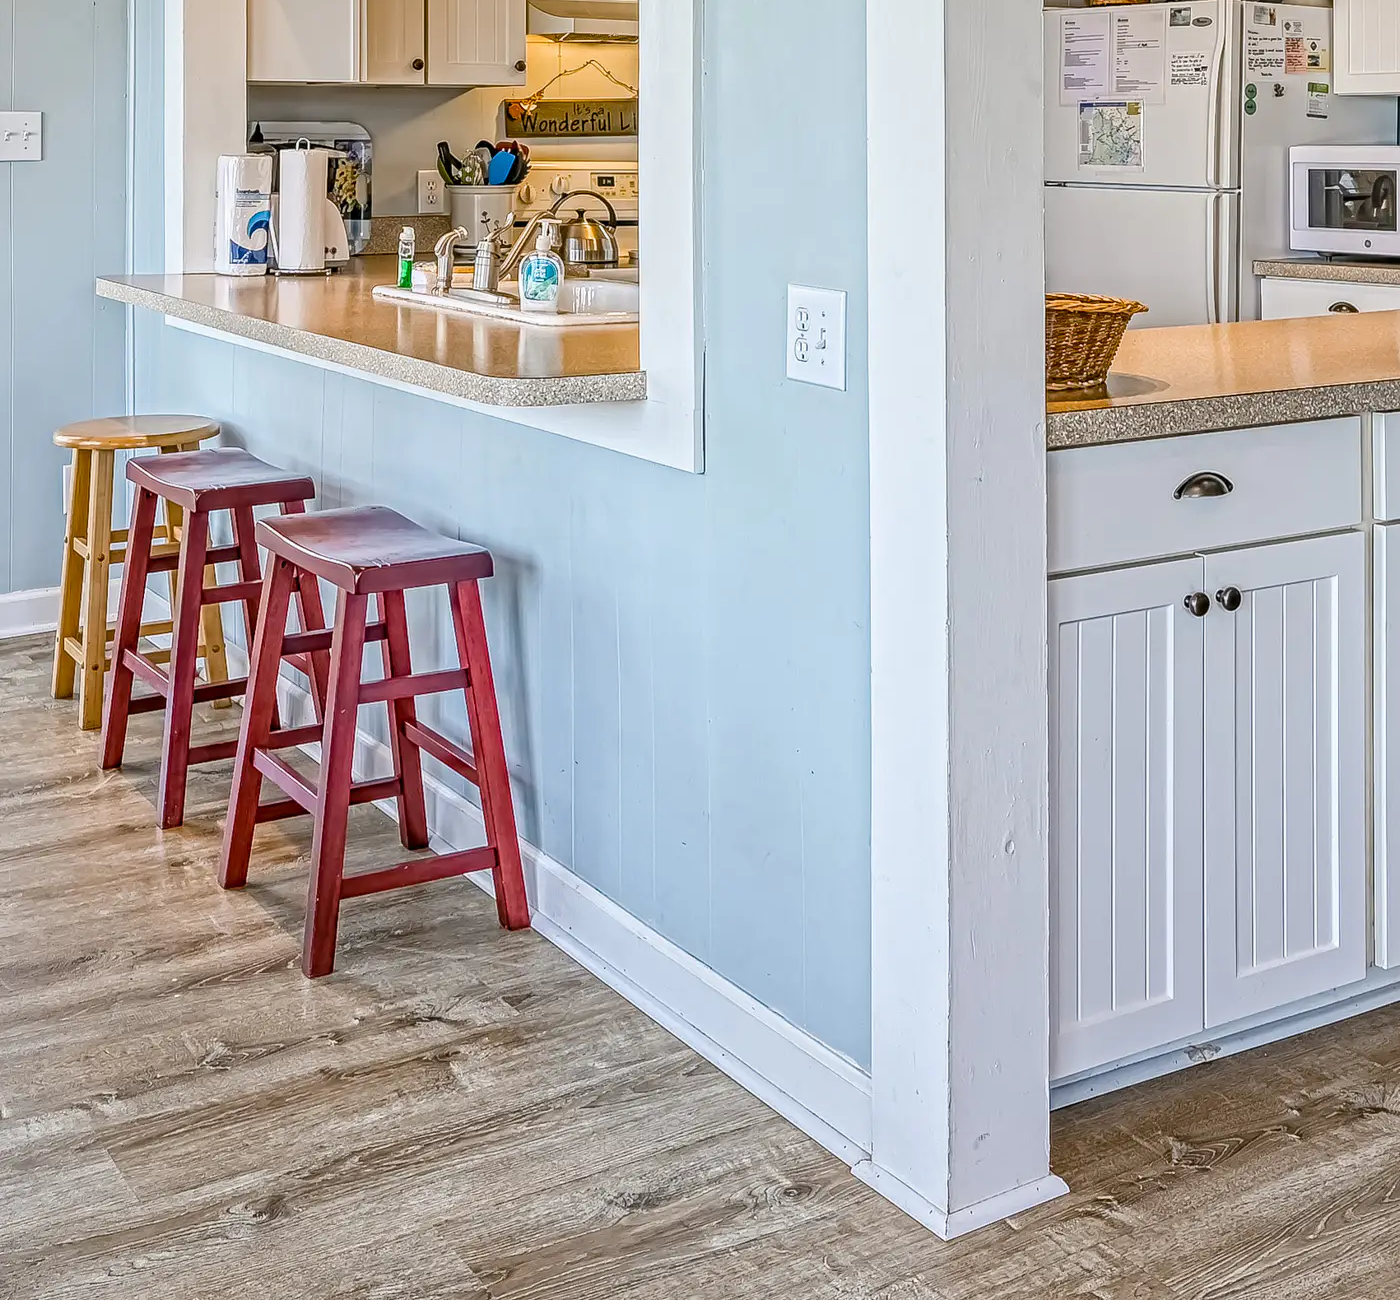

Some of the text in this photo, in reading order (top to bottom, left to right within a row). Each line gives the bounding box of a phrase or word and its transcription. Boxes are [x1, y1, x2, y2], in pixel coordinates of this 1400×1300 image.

[572, 102, 605, 116] It's a
[521, 110, 611, 133] Wonderful
